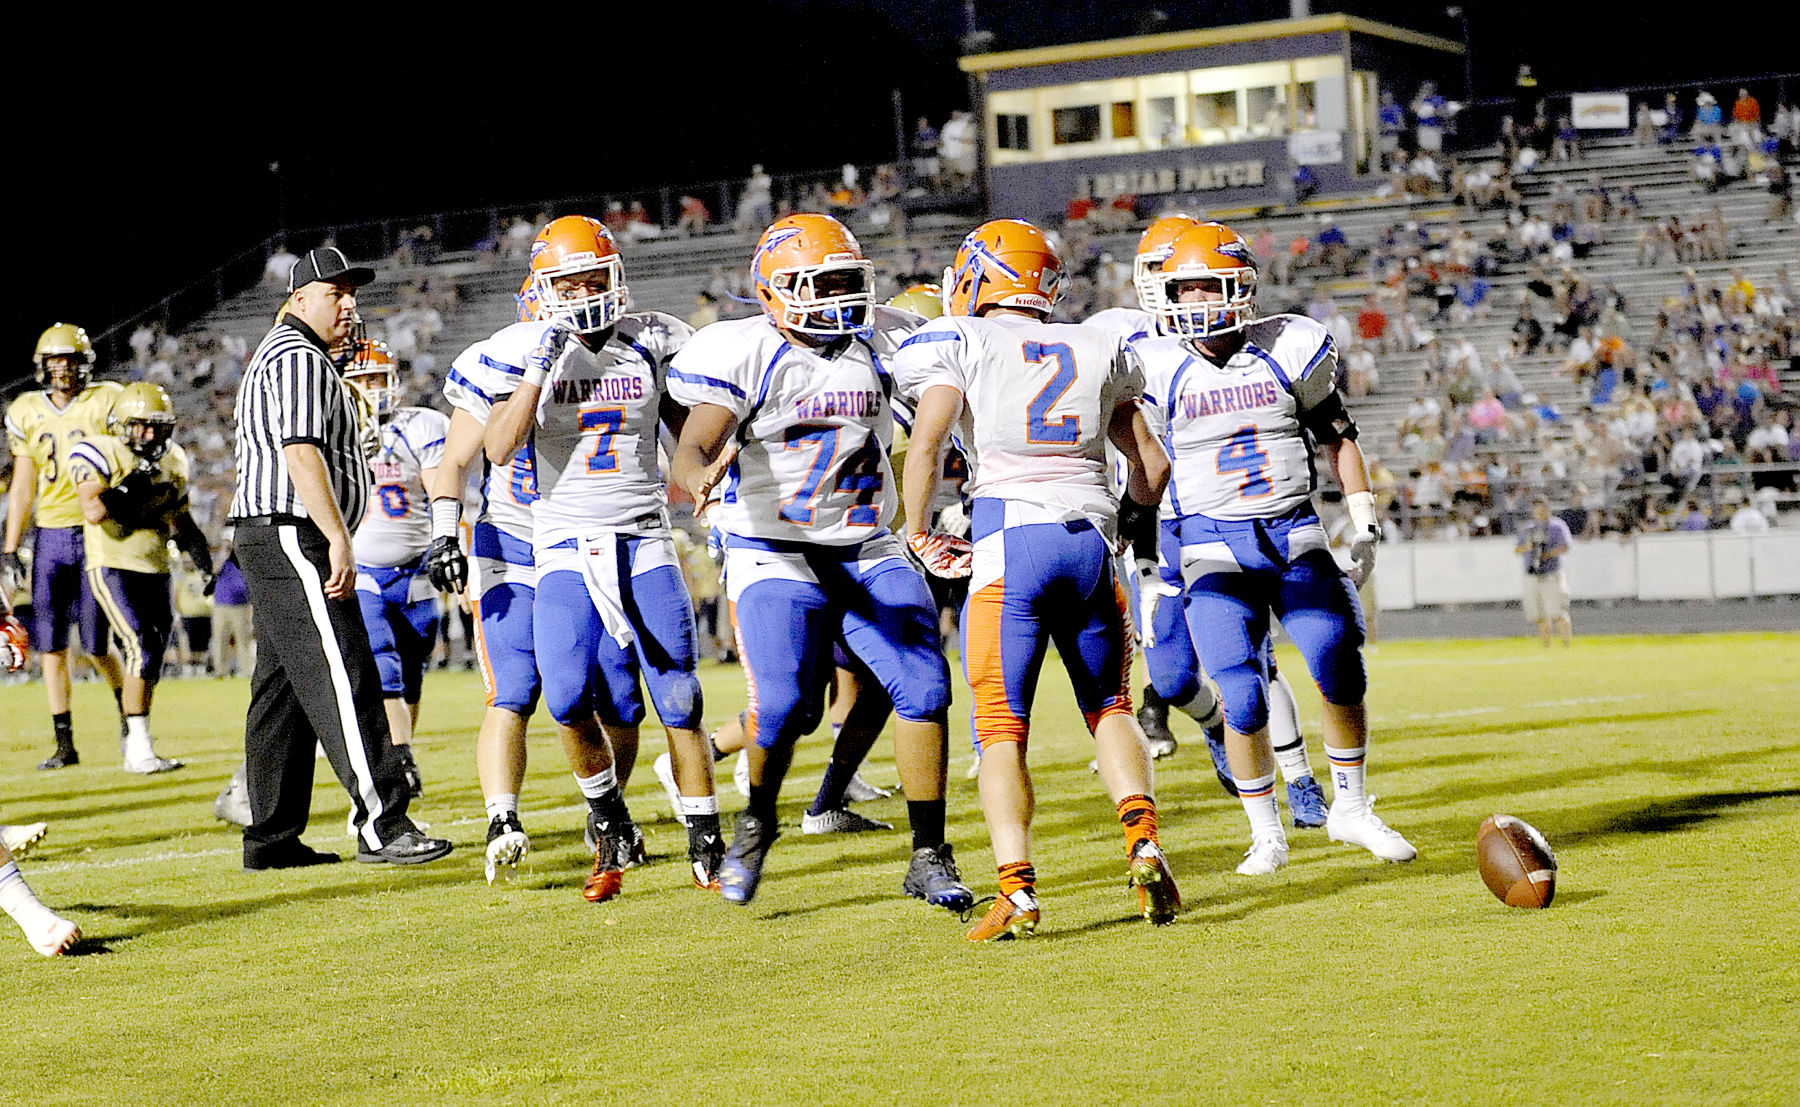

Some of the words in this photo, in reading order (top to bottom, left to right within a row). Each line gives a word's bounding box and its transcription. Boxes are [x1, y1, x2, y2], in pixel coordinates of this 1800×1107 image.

[552, 377, 643, 404] WARRIORS
[795, 390, 882, 419] WARRIORS
[1022, 340, 1082, 445] 2
[1182, 380, 1278, 419] WARRIORS
[578, 404, 627, 475] 7
[778, 423, 884, 527] 74
[1215, 423, 1275, 500] 4
